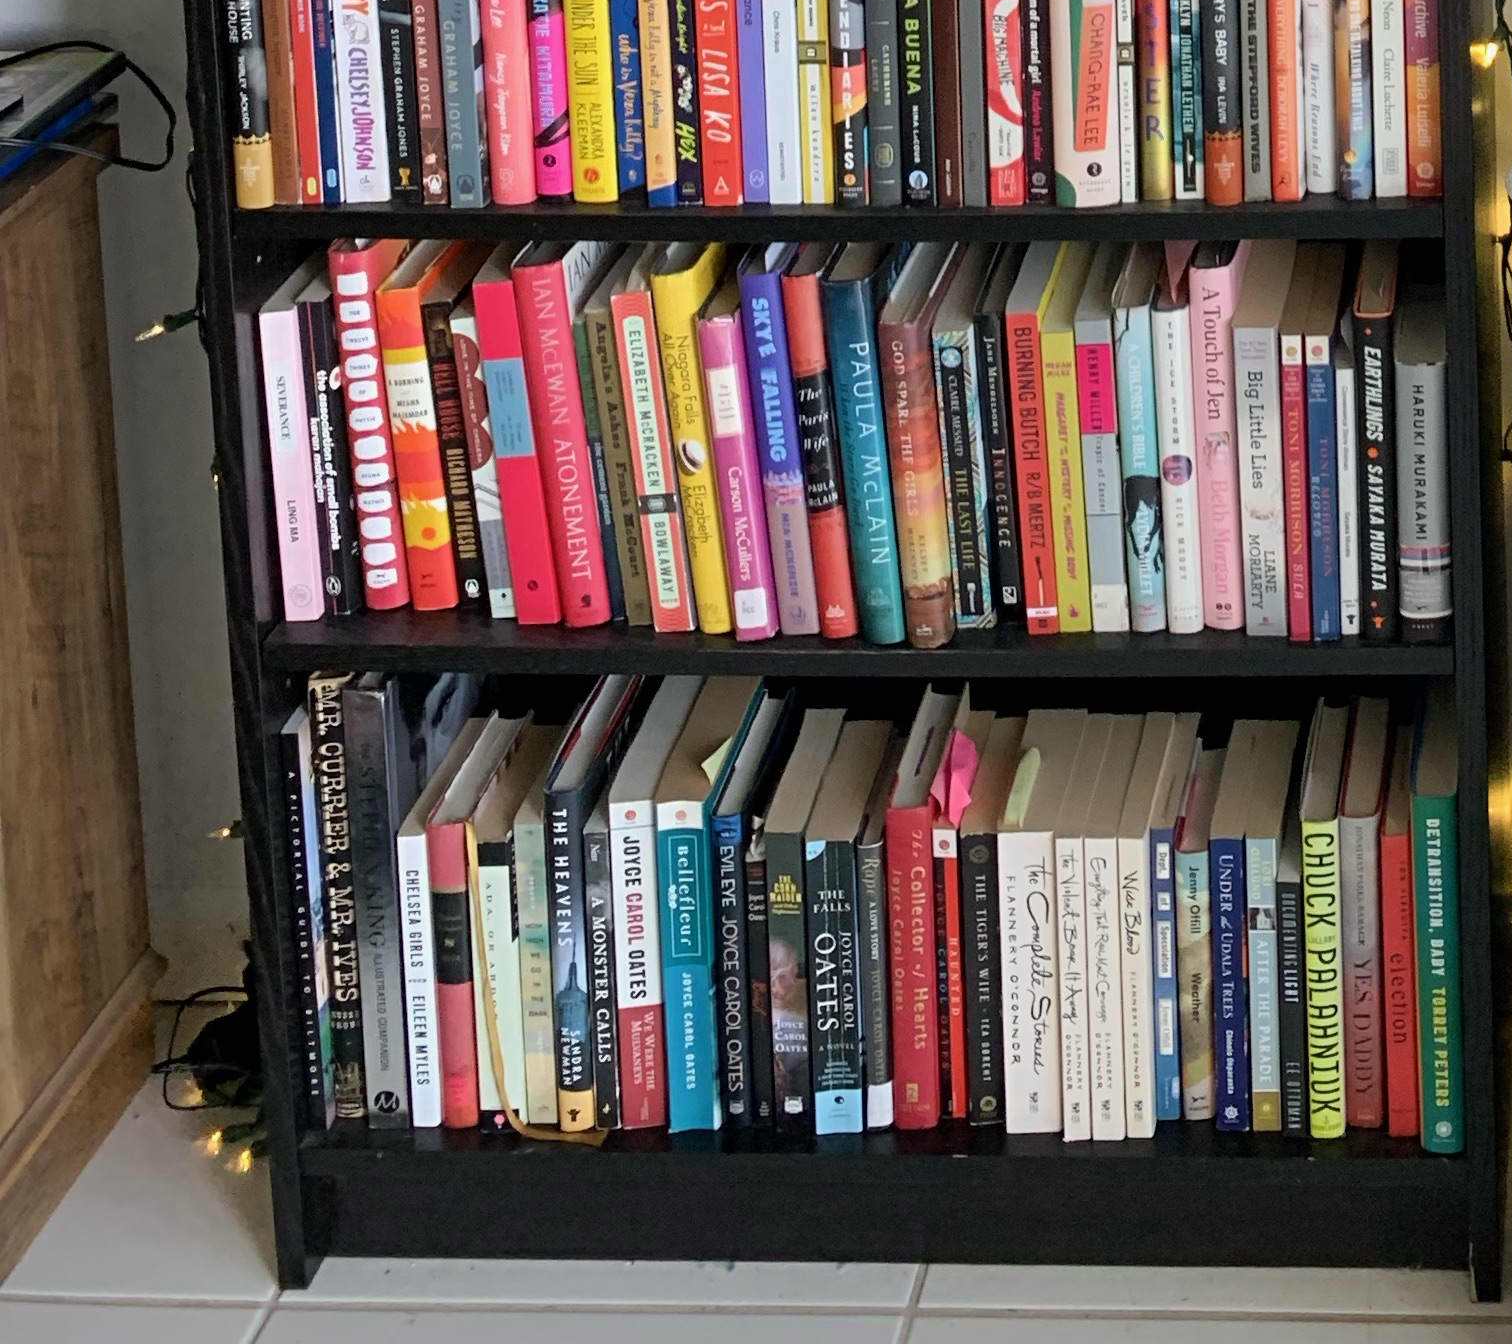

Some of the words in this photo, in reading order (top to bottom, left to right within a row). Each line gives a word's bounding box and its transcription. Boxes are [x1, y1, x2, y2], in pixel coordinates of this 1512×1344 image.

[227, 2, 238, 43] HOUSE
[702, 48, 729, 96] LISA
[905, 18, 922, 94] BUENA
[1180, 34, 1193, 87] JONATHAN
[1214, 30, 1227, 66] BABY
[706, 111, 731, 143] KO
[1181, 91, 1195, 133] LETHEM
[1203, 287, 1219, 301] A
[752, 298, 775, 356] SKYE
[1204, 307, 1224, 363] Touch
[1014, 326, 1037, 401] BURNING
[1207, 369, 1225, 385] of
[1246, 370, 1264, 399] Big
[276, 376, 291, 440] SEVERANCE
[761, 370, 787, 462] FALLING
[1206, 388, 1225, 420] Jen
[1364, 346, 1383, 441] EARTHLINGS
[1412, 385, 1426, 446] HARUKI
[532, 279, 557, 319] IAN
[553, 439, 591, 580] ATONEMENT
[1017, 408, 1040, 460] BUTCH
[1249, 403, 1266, 450] Little
[1026, 472, 1043, 498] R/B
[1251, 454, 1266, 489] Lies
[1367, 464, 1384, 525] SAYAKA
[287, 500, 298, 523] LING
[1414, 454, 1428, 541] MURAKAMI
[289, 527, 300, 543] MA
[1029, 504, 1045, 549] MERTZ
[1249, 534, 1264, 609] MORIARTY
[1264, 550, 1276, 593] LIANE
[1370, 530, 1387, 590] MURATA
[287, 772, 296, 780] A
[290, 795, 304, 891] PICTORIAL
[623, 836, 641, 887] JOYCE
[406, 870, 421, 925] CHELSEA
[975, 875, 988, 901] THE
[1187, 866, 1202, 901] Jenny
[1305, 833, 1336, 930] CHUCK
[297, 907, 309, 961] GUIDE
[626, 893, 644, 945] CAROL
[976, 909, 990, 962] TIGER'S
[1190, 905, 1202, 934] Offill
[408, 931, 423, 968] GIRLS
[302, 975, 312, 994] TO
[630, 950, 646, 1000] OATES
[978, 968, 991, 1002] WIFE
[1191, 972, 1203, 1023] Weather
[412, 996, 427, 1039] EILEEN
[1308, 949, 1341, 1115] PALAHNIUK
[305, 1009, 319, 1096] BILTMORE
[415, 1045, 430, 1086] MYLES
